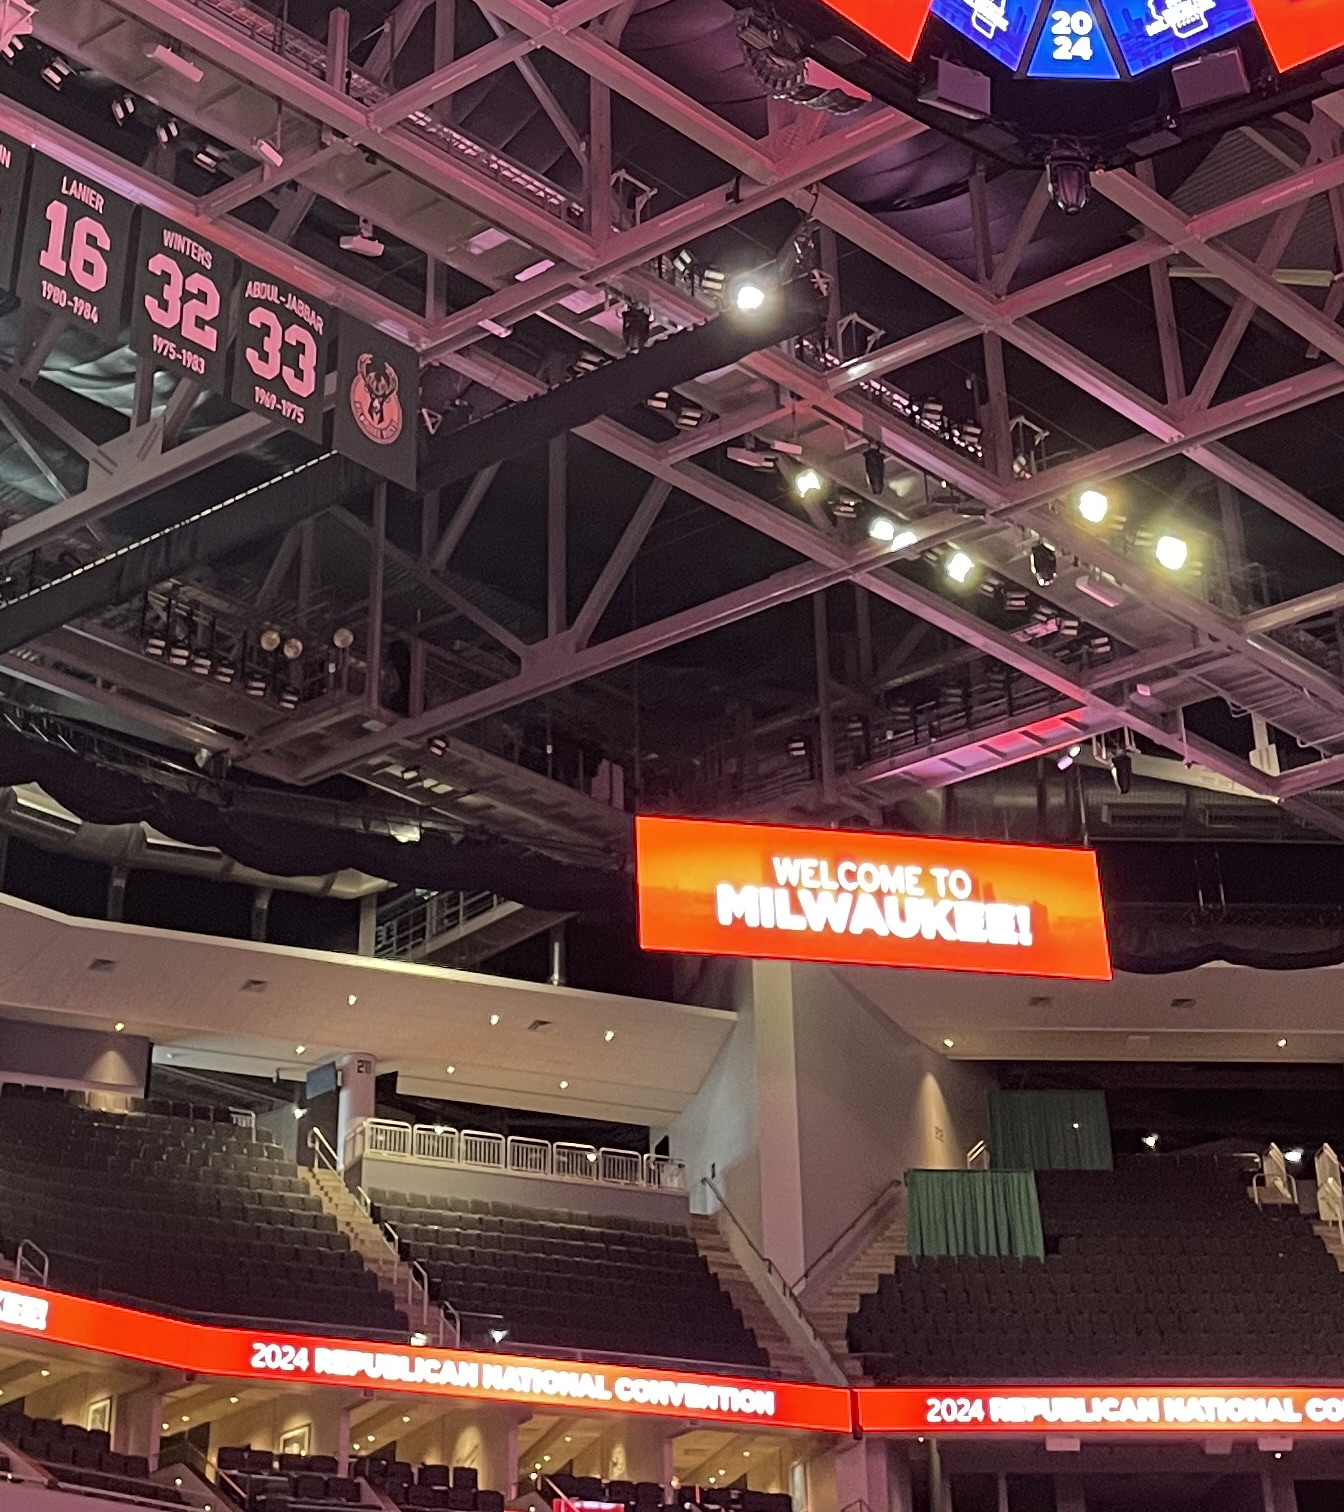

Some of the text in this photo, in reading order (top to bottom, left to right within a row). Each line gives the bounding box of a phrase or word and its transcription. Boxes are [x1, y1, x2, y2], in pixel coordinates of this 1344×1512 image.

[1051, 10, 1093, 36] 20
[1052, 35, 1094, 61] 24
[61, 176, 105, 215] LANIER
[38, 199, 111, 292] 16
[162, 228, 214, 271] WINTERS
[144, 253, 221, 352] 32
[245, 280, 324, 335] ABDUL-JABBAR
[151, 334, 207, 376] 1975-1983
[246, 306, 317, 398] 33
[772, 856, 972, 899] WELCOME TO
[715, 883, 1033, 947] MILWAUKEE!
[251, 1342, 776, 1417] 2024 REPUBLICAN NATIONAL CONVENTION
[925, 1397, 985, 1424] 2024
[989, 1397, 1159, 1423] REPUBLICAN
[1163, 1397, 1302, 1423] NATIONAL
